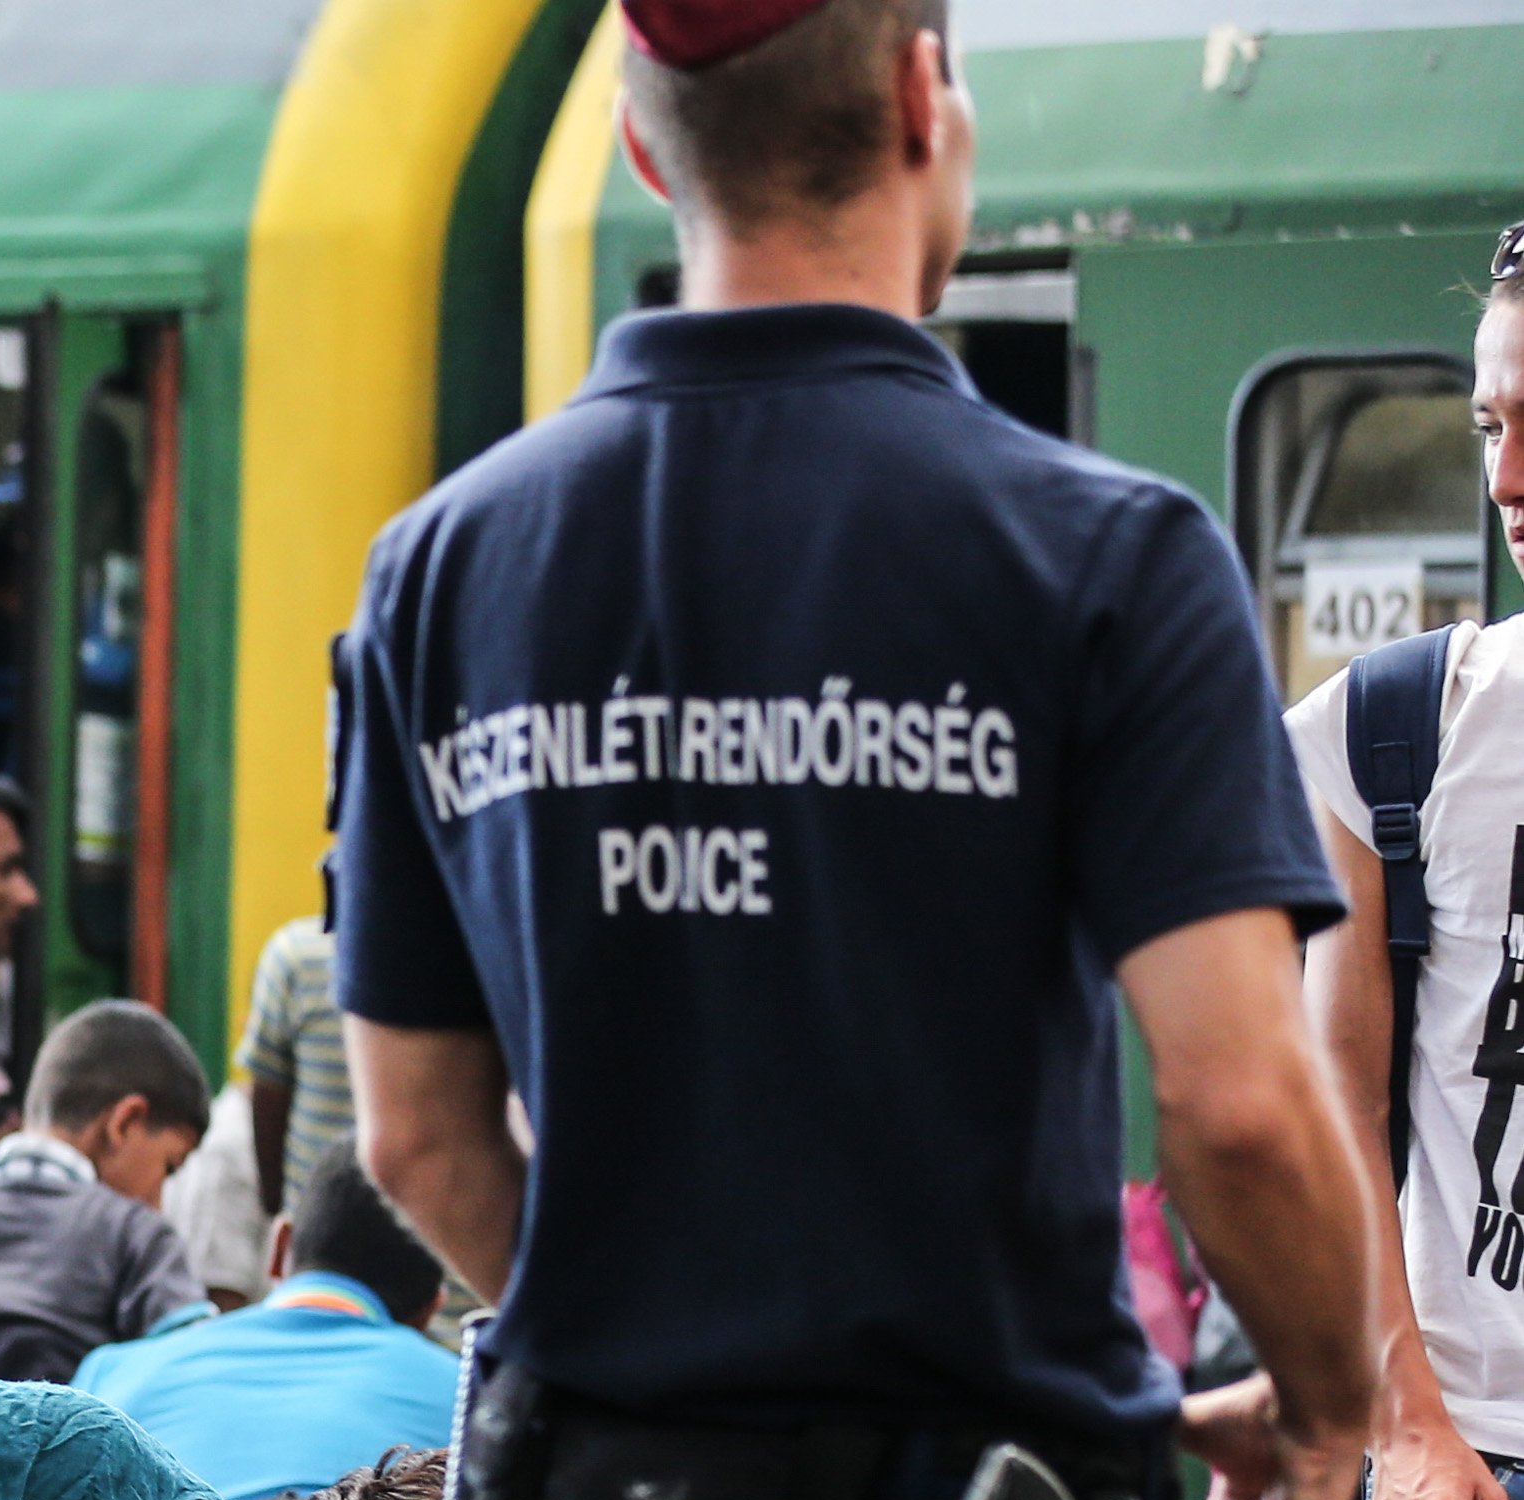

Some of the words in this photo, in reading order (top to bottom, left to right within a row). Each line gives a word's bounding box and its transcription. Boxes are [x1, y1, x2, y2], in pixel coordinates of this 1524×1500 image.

[1313, 589, 1410, 641] 402
[679, 674, 1018, 798] RENDŐRSÉG
[1466, 1203, 1524, 1293] YO
